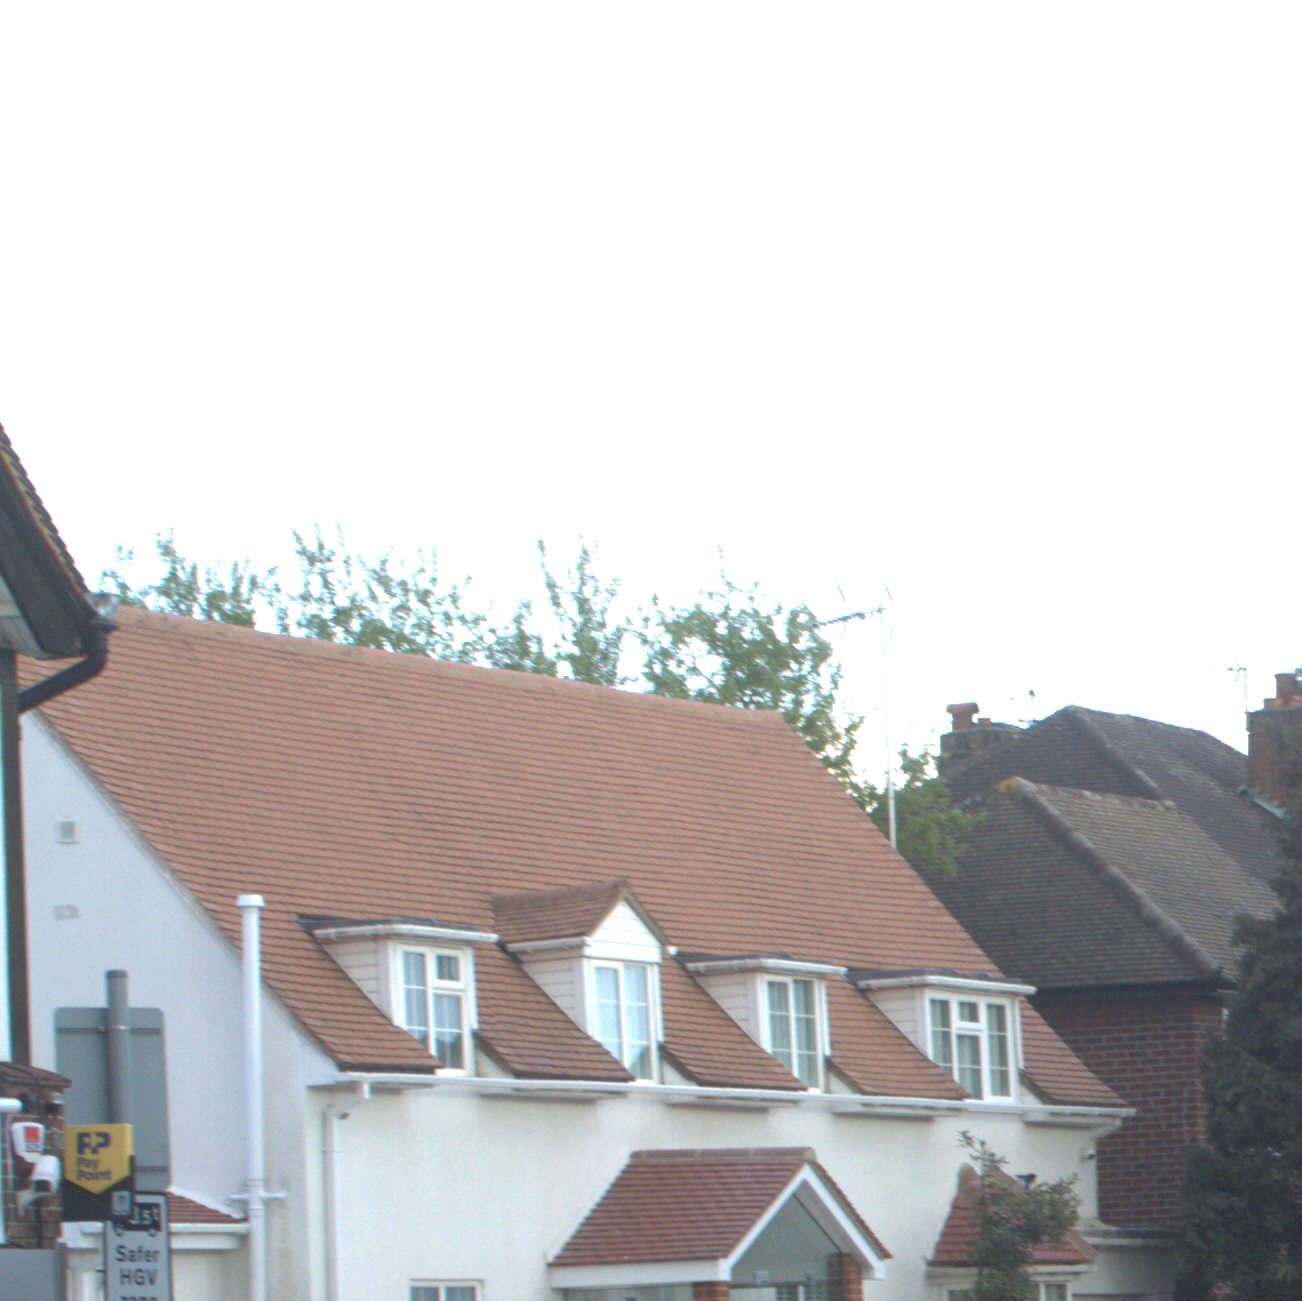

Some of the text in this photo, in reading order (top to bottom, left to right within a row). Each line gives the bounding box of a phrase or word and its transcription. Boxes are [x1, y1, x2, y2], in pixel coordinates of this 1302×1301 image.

[77, 1156, 99, 1170] Pay
[76, 1169, 112, 1181] Point
[115, 1245, 160, 1263] Safer
[119, 1268, 159, 1286] HGV
